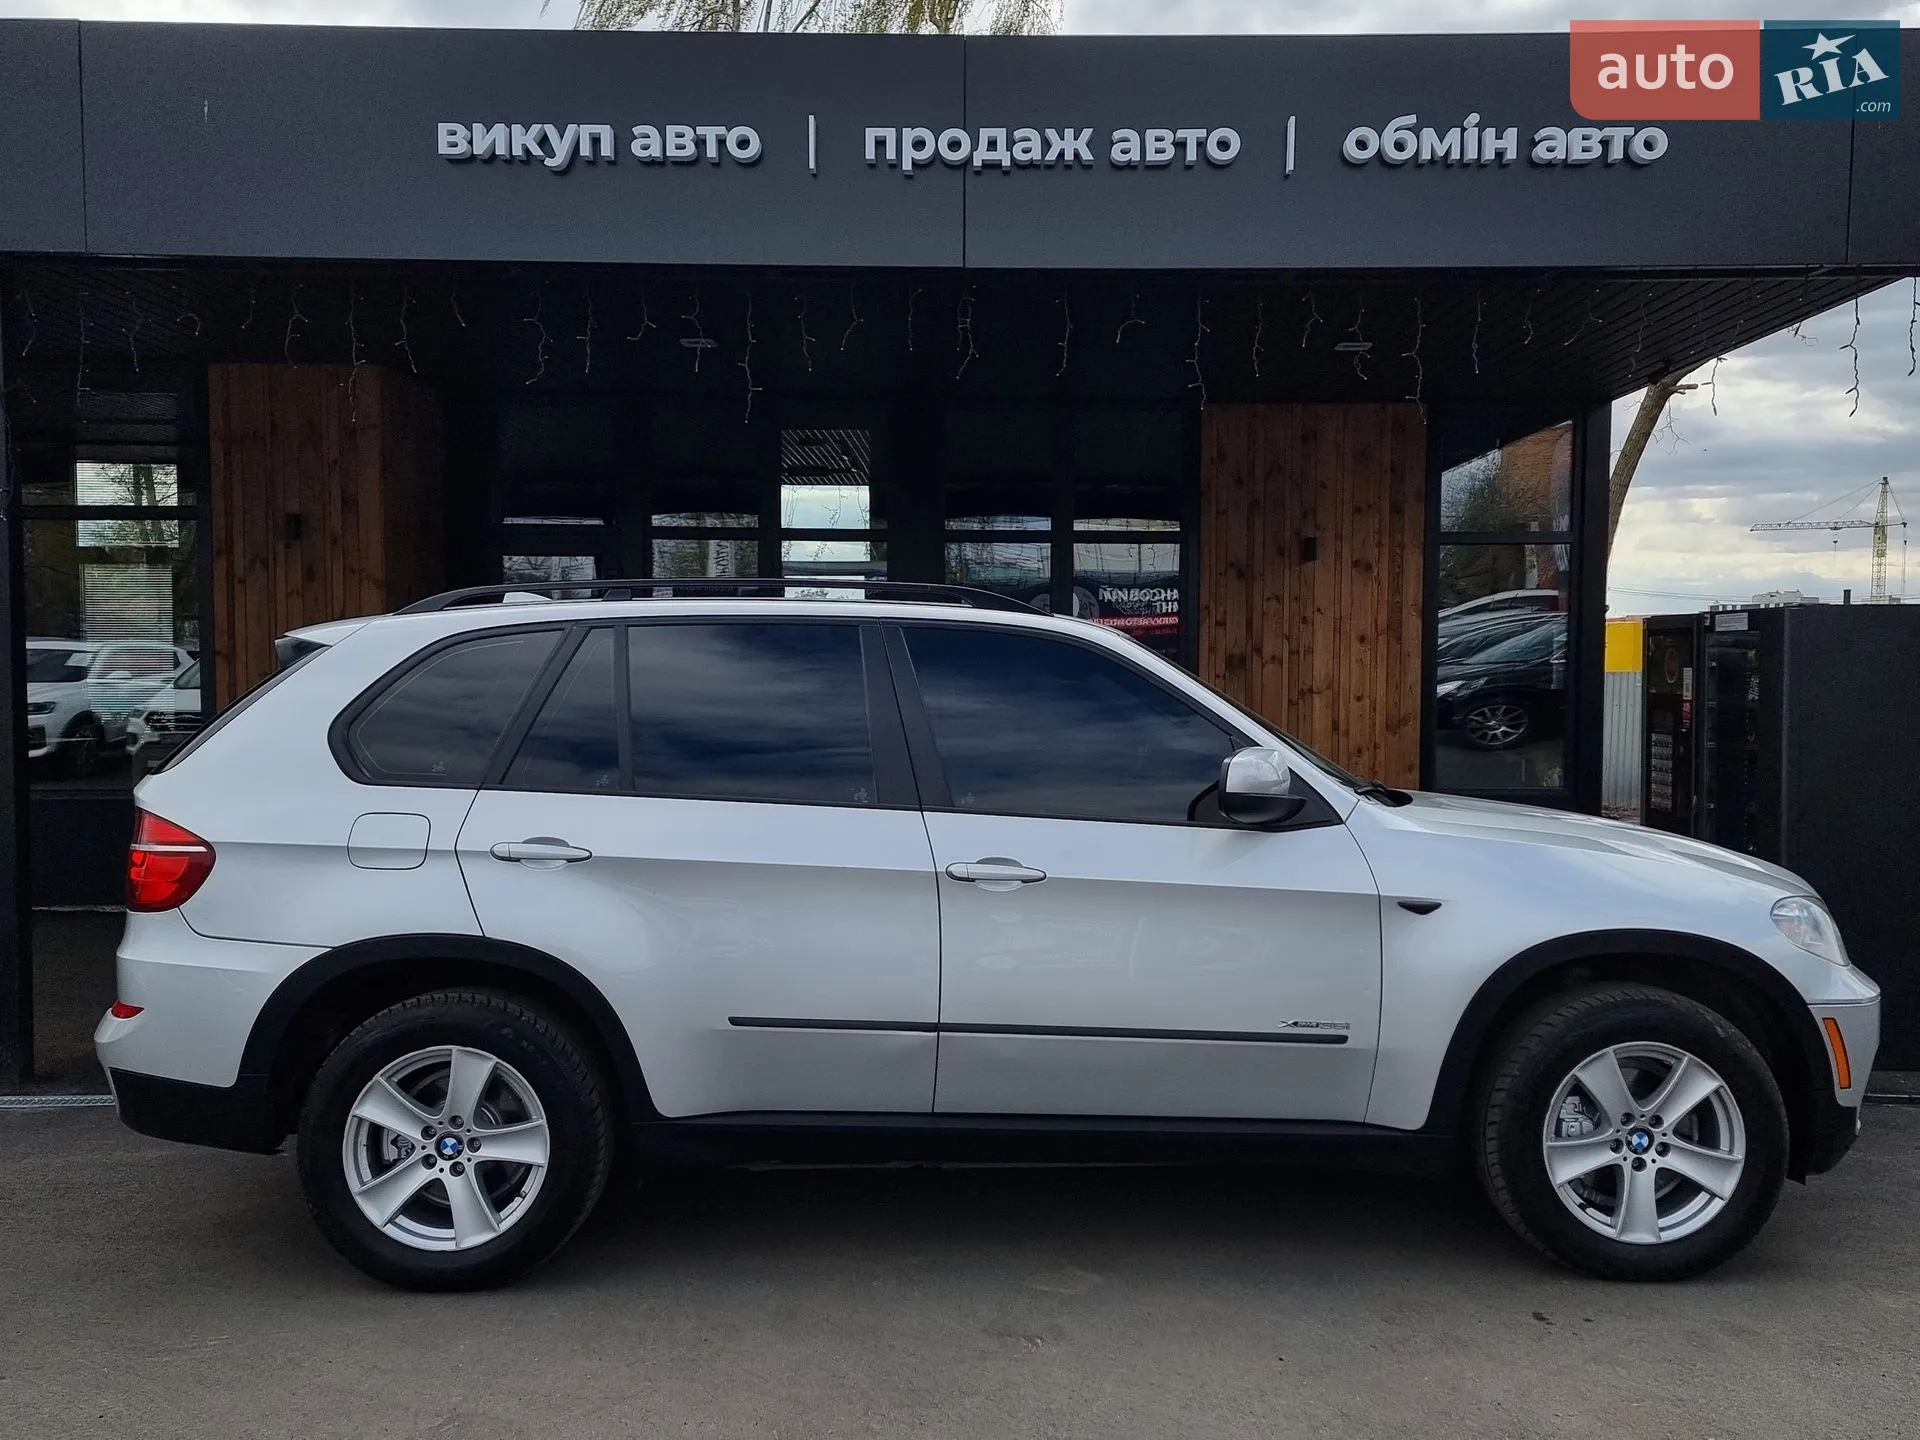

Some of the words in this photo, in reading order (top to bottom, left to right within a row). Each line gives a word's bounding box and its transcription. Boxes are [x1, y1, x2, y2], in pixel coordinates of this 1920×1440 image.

[437, 122, 615, 172] викуп
[630, 124, 762, 164] авто
[864, 126, 1095, 175] продаж
[1110, 126, 1241, 166] авто
[1342, 112, 1518, 164] обмін
[1531, 125, 1669, 164] авто
